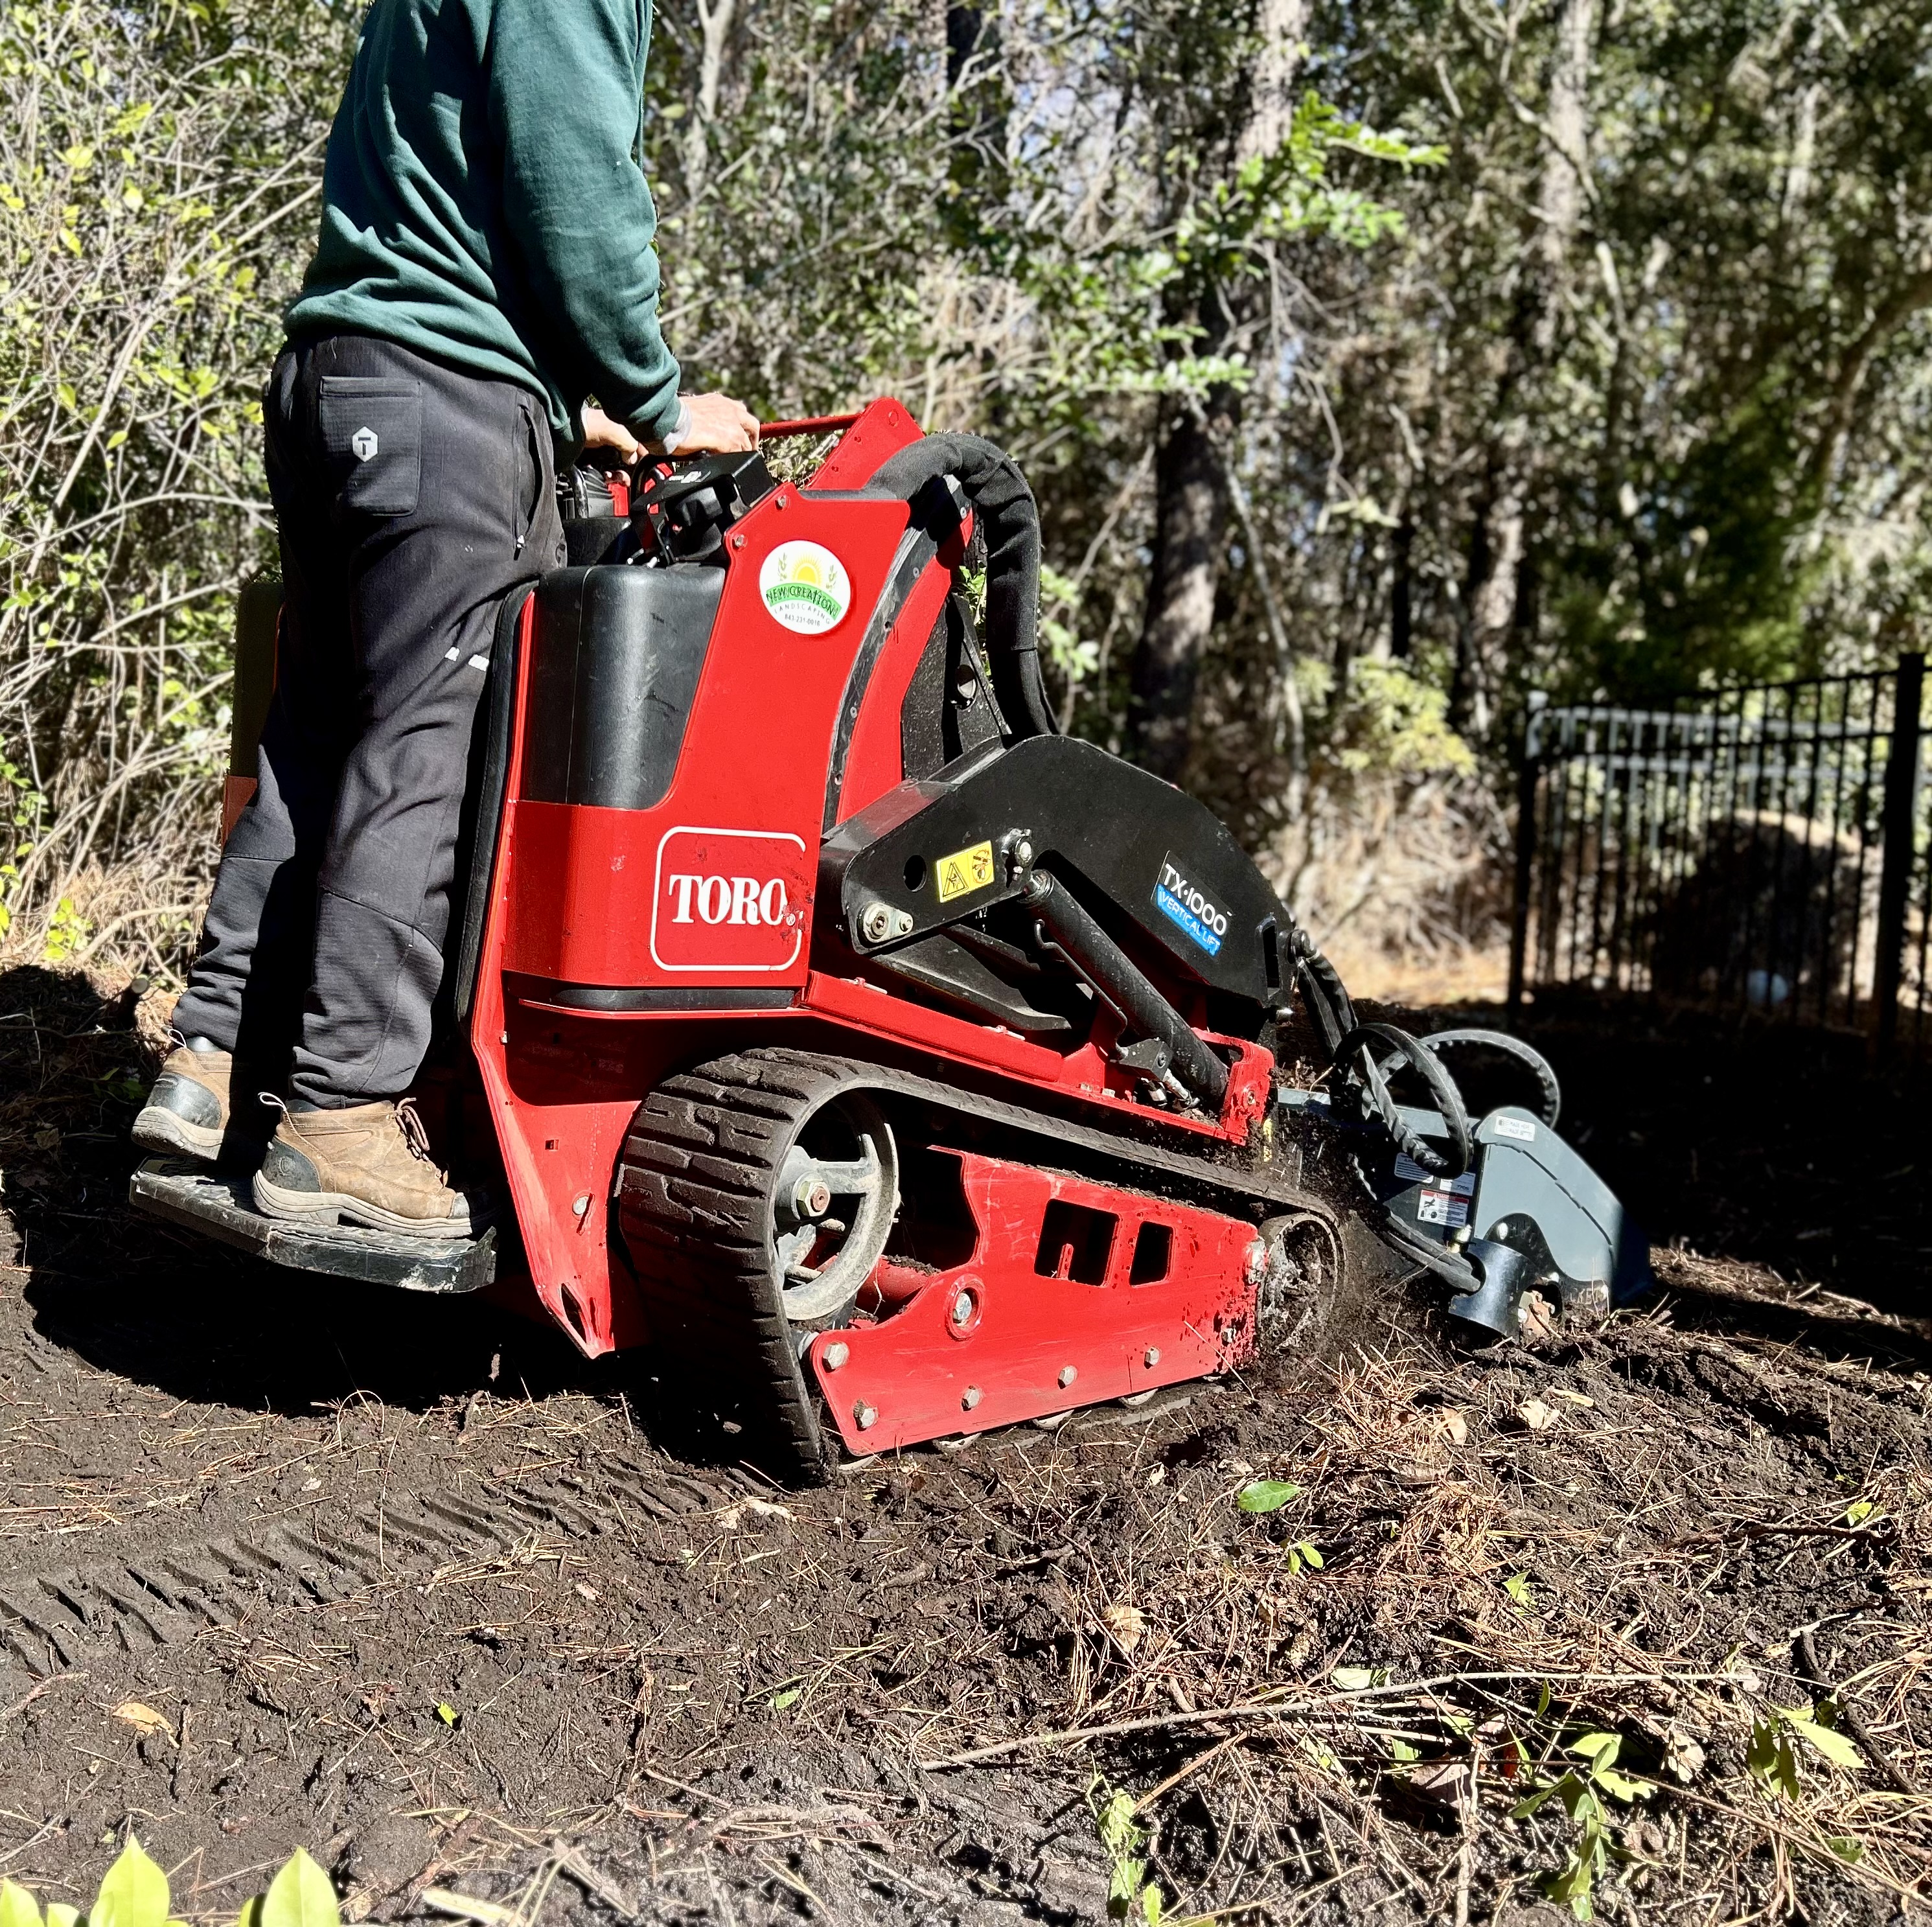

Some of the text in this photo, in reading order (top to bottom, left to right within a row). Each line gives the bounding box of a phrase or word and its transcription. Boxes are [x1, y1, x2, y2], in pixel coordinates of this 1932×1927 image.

[766, 586, 787, 603] NEW
[774, 603, 831, 625] LANDSCAPING
[668, 874, 788, 926] TORO
[1162, 891, 1221, 951] VERTICAL LIFT
